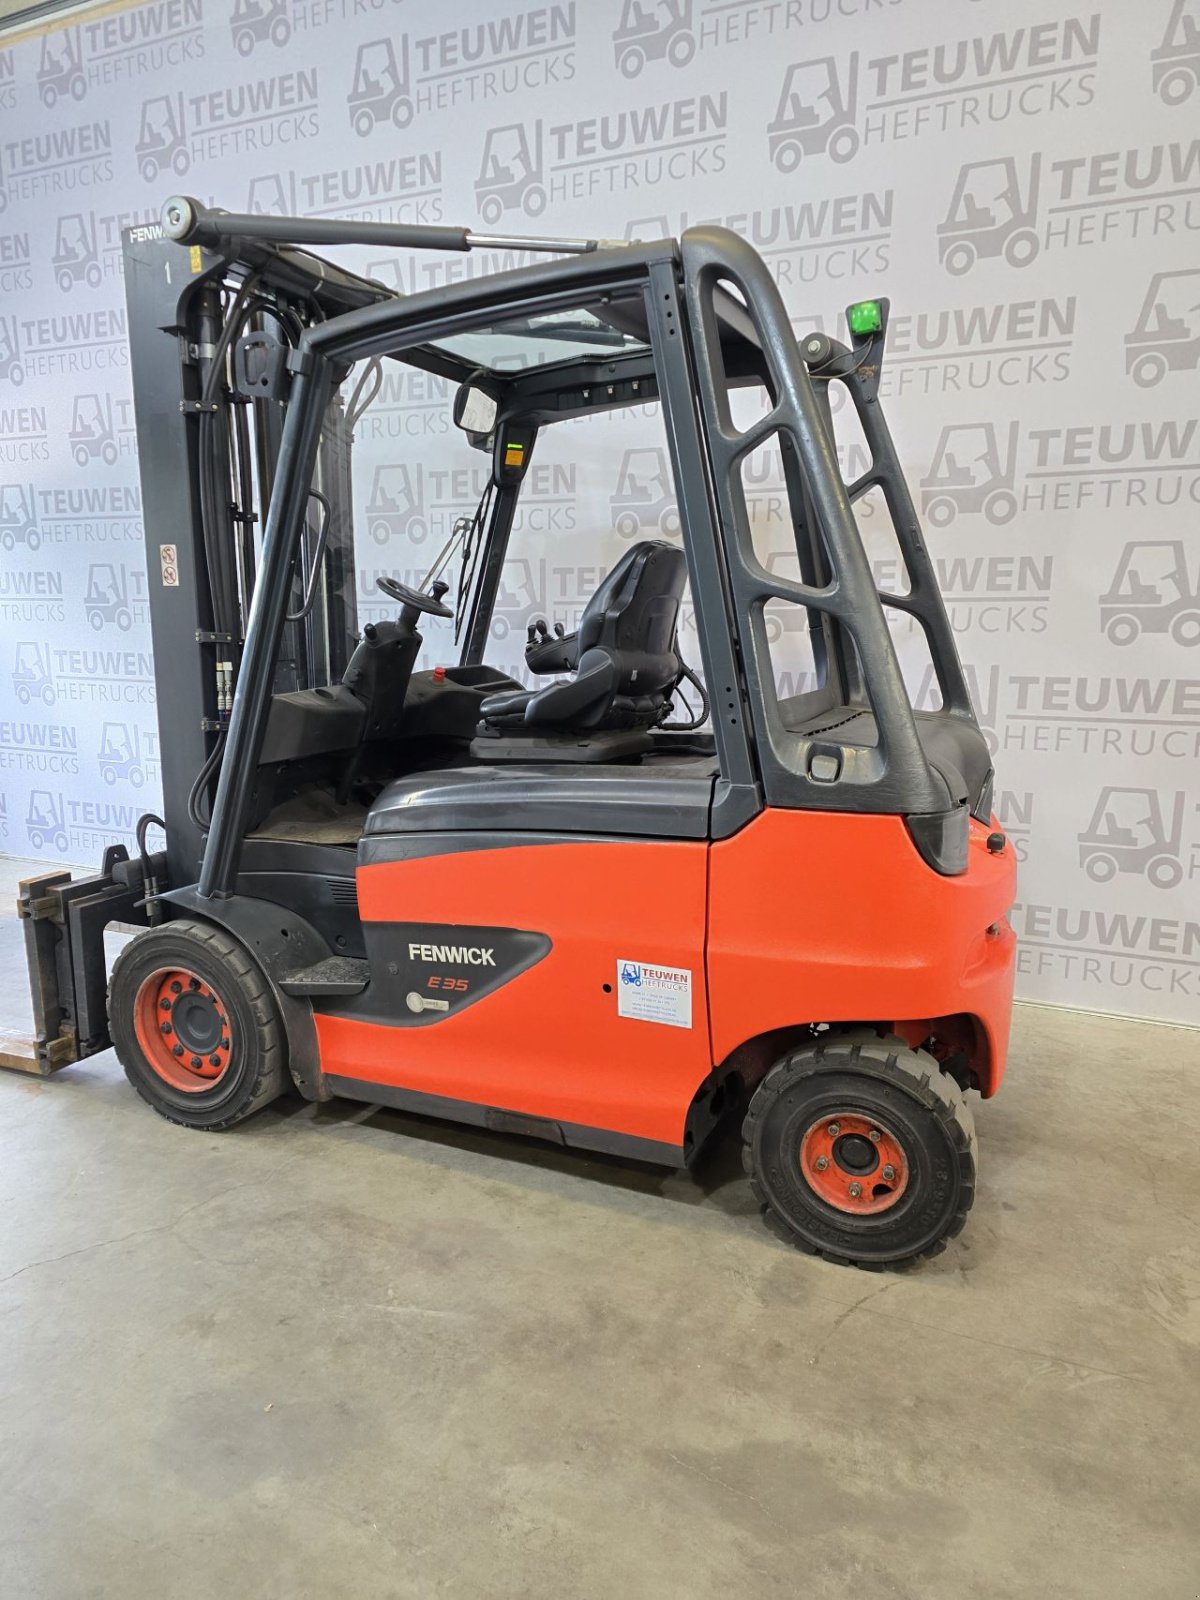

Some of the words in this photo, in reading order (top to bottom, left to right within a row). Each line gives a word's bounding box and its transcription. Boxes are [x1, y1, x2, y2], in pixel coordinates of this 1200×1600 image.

[86, 0, 202, 53] TEUWEN
[416, 2, 576, 71] TEUWEN
[88, 34, 206, 88] HEFTRUCKS
[868, 14, 1101, 97] TEUWEN
[189, 67, 319, 118] TEUWEN
[417, 53, 576, 114] HEFTRUCKS
[550, 91, 728, 160] TEUWEN
[864, 74, 1096, 145] HEFTRUCKS
[5, 120, 111, 169] TEUWEN
[192, 113, 320, 163] HEFTRUCKS
[8, 158, 114, 203] HEFTRUCKS
[301, 150, 442, 207] TEUWEN
[550, 144, 726, 203] HEFTRUCKS
[1051, 139, 1200, 200] TEUW
[1045, 200, 1200, 250] HEFTRU
[21, 308, 125, 346] TEUWEN
[886, 296, 1077, 354] EUWEN
[24, 346, 128, 377] HEFTRUCKS
[879, 353, 1071, 397] EFTRUCKS
[359, 412, 449, 439] TRUCKS
[1029, 419, 1200, 466] TEUW
[38, 487, 140, 514] TEUWEN
[41, 521, 142, 543] HEFTRUCKS
[54, 650, 154, 676] TEUWEN
[1009, 676, 1200, 715] TEUWE
[0, 722, 77, 748] EUWEN
[0, 752, 79, 774] EFTRUCKS
[408, 943, 496, 967] FENWICK
[642, 968, 688, 983] TEUWEN
[642, 979, 688, 992] HEFTRUCKS
